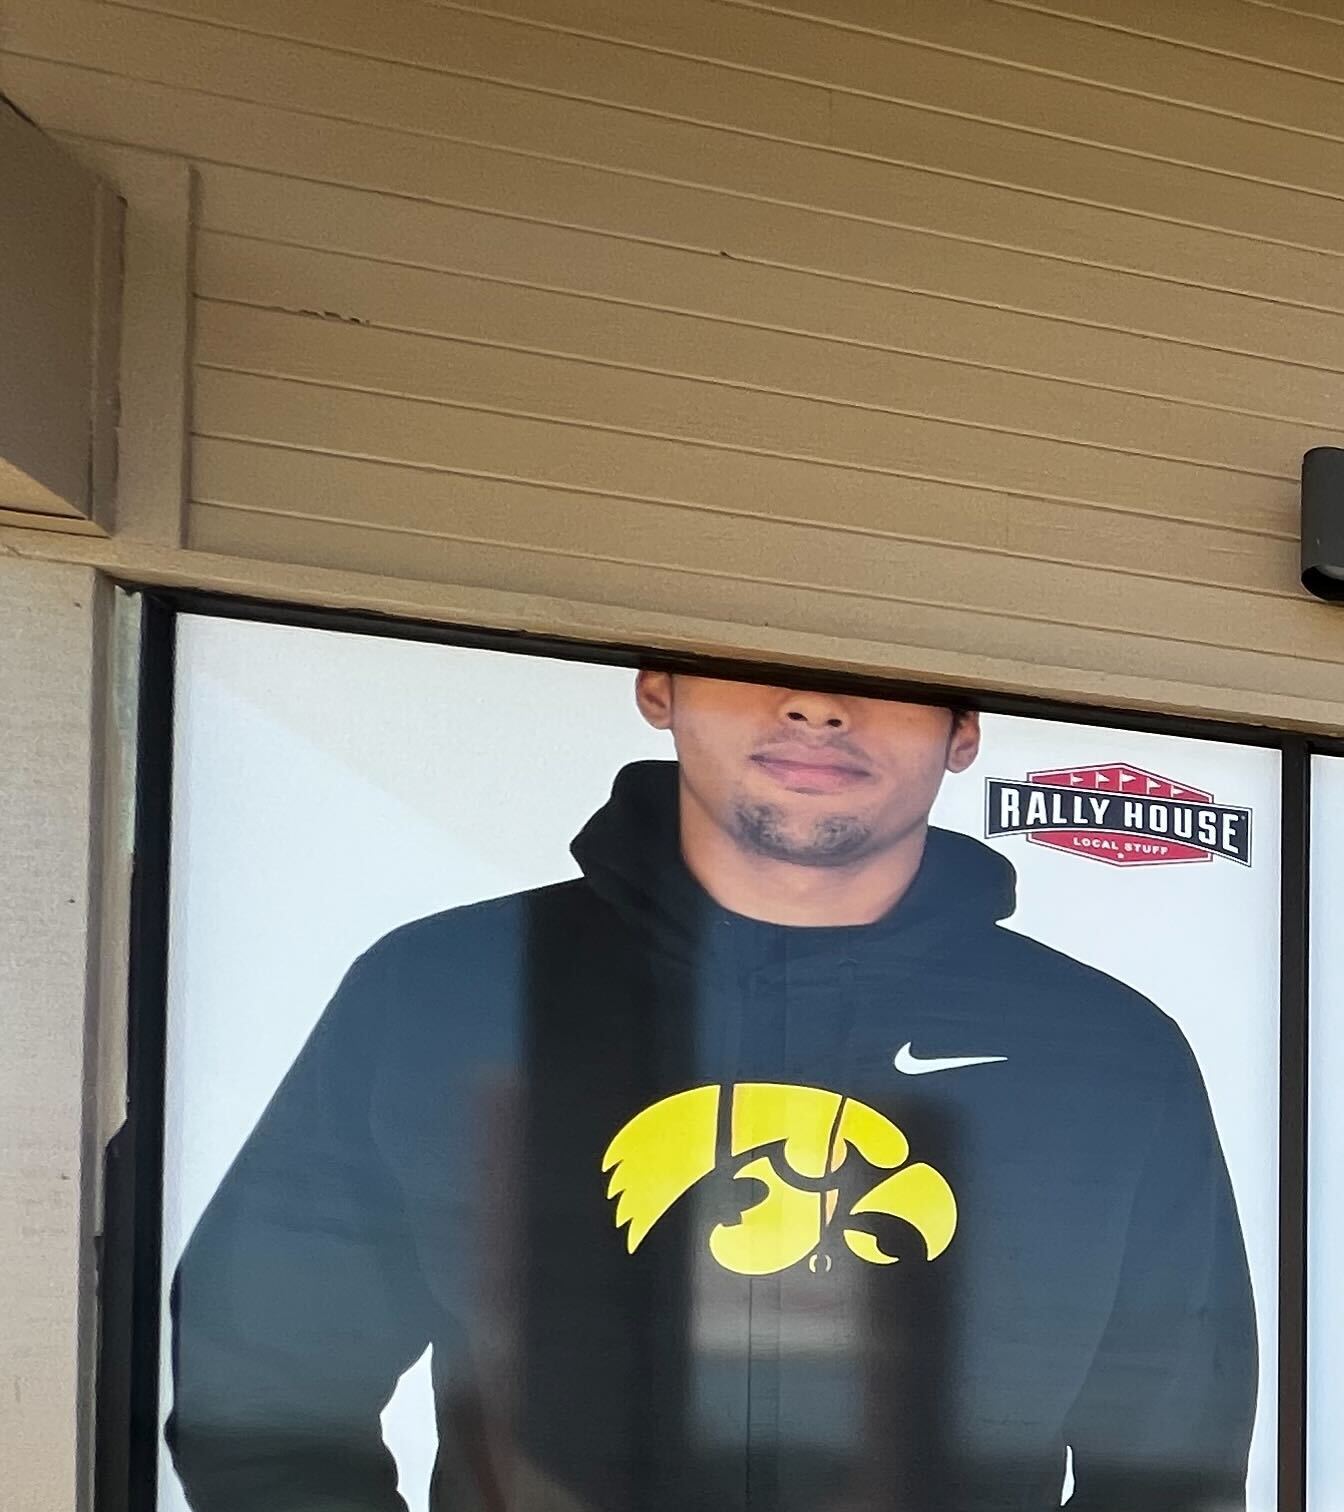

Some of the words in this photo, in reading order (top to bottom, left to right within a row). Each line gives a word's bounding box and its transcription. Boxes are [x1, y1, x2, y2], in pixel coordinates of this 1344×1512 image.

[1000, 787, 1111, 829] RALLY
[1123, 801, 1240, 854] HOUSE
[1073, 837, 1119, 851] LOCAL
[1124, 842, 1169, 856] STUFF
